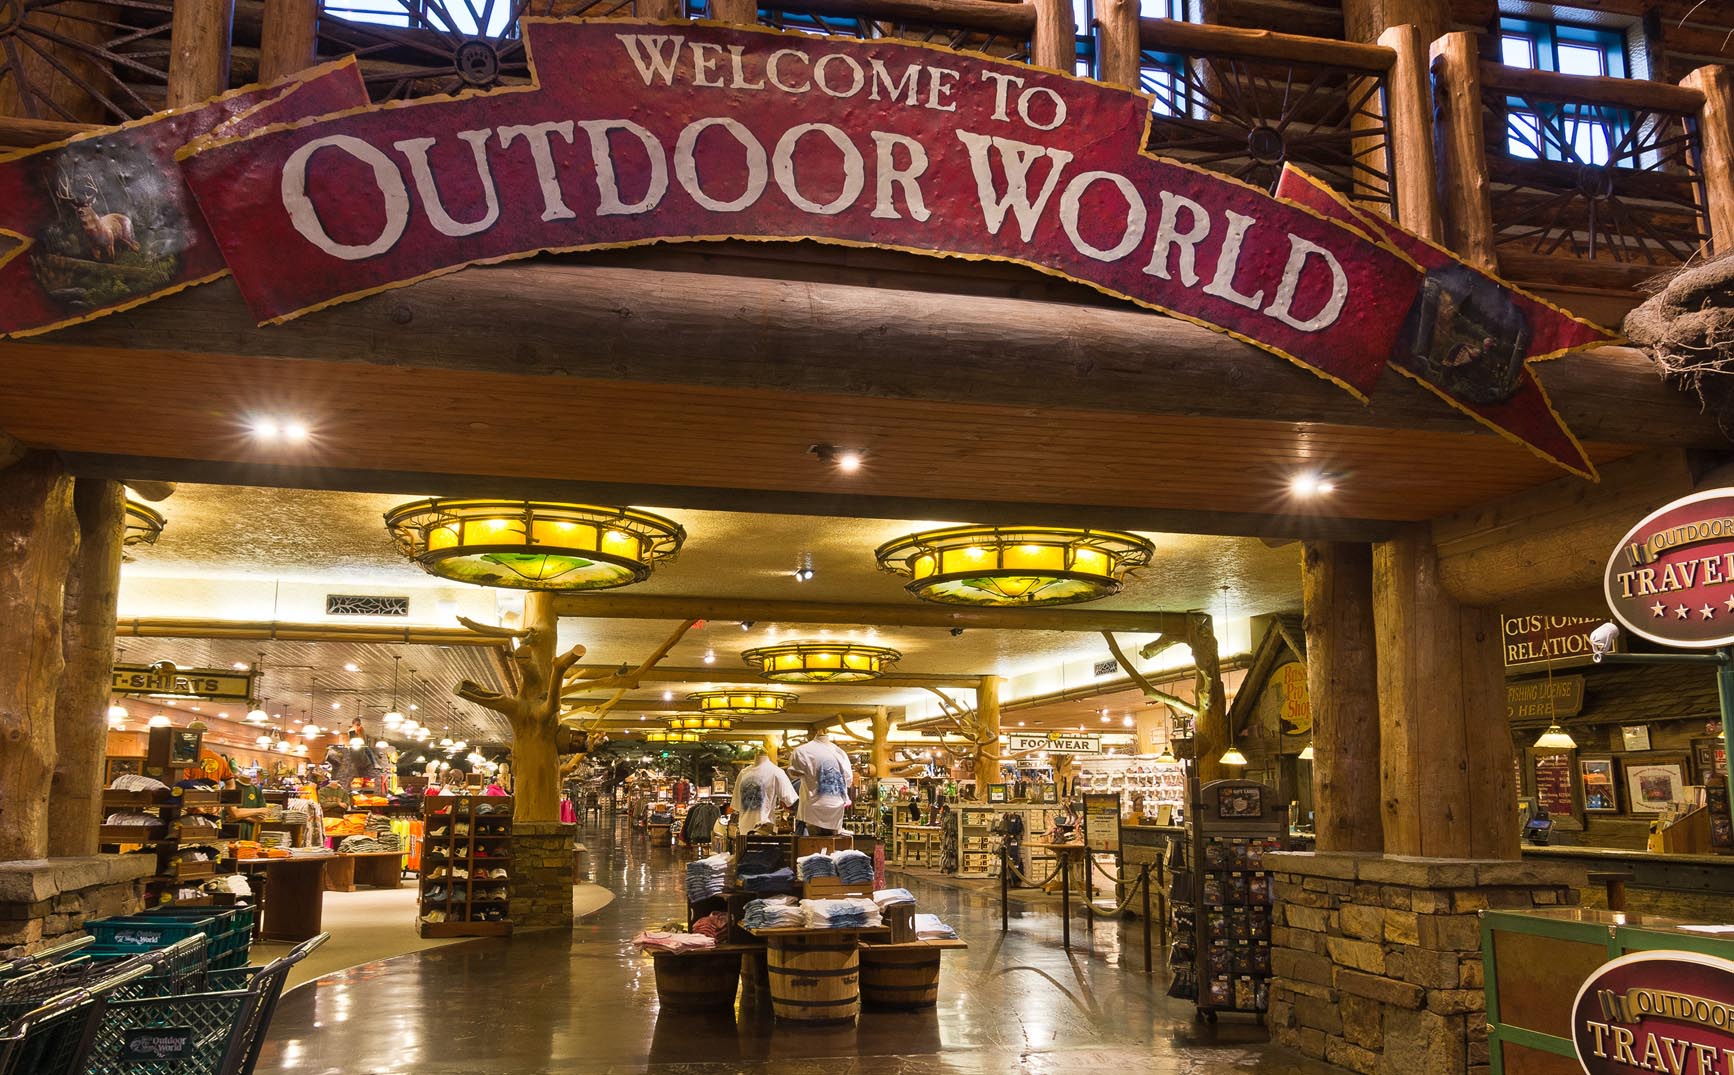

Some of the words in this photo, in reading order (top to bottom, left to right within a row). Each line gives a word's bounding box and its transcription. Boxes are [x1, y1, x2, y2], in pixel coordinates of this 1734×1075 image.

[616, 33, 959, 112] WELCOME
[981, 70, 1068, 131] TO
[281, 116, 932, 261] OUTDOOR
[955, 129, 1349, 332] WORLD
[1505, 614, 1603, 636] CUSTOM
[1507, 633, 1604, 661] RELATION
[1287, 700, 1311, 719] Shop
[1519, 703, 1552, 717] HERE
[152, 1036, 187, 1045] Outdoor
